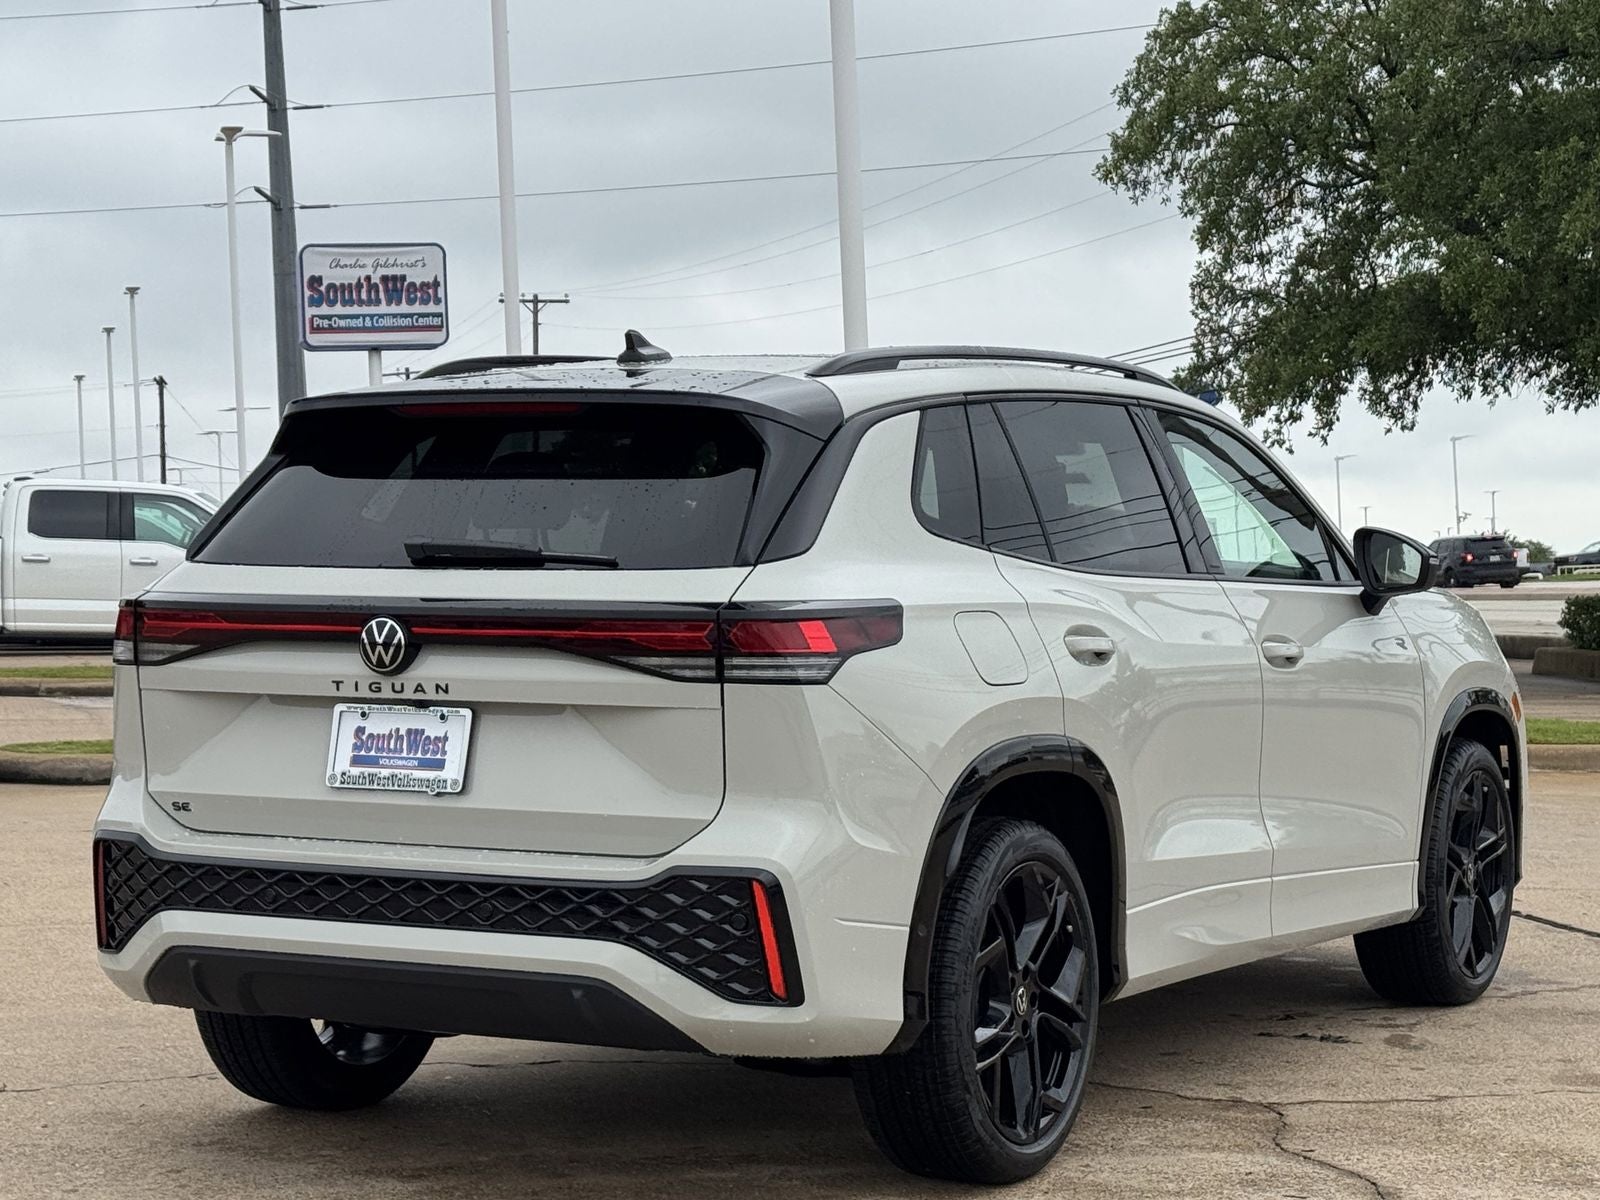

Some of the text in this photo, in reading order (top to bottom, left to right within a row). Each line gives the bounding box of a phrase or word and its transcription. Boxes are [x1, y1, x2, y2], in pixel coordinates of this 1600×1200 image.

[329, 256, 427, 274] Charlie Gilchrist's
[306, 273, 442, 308] SouthWest
[313, 315, 442, 328] Pre-Owned & Collision Center
[331, 680, 449, 695] TIGUAN
[352, 725, 449, 757] SouthWest
[378, 758, 419, 767] VOLKSWAGEN
[340, 770, 448, 792] SouthWestVolkswagen
[171, 801, 192, 811] SE
